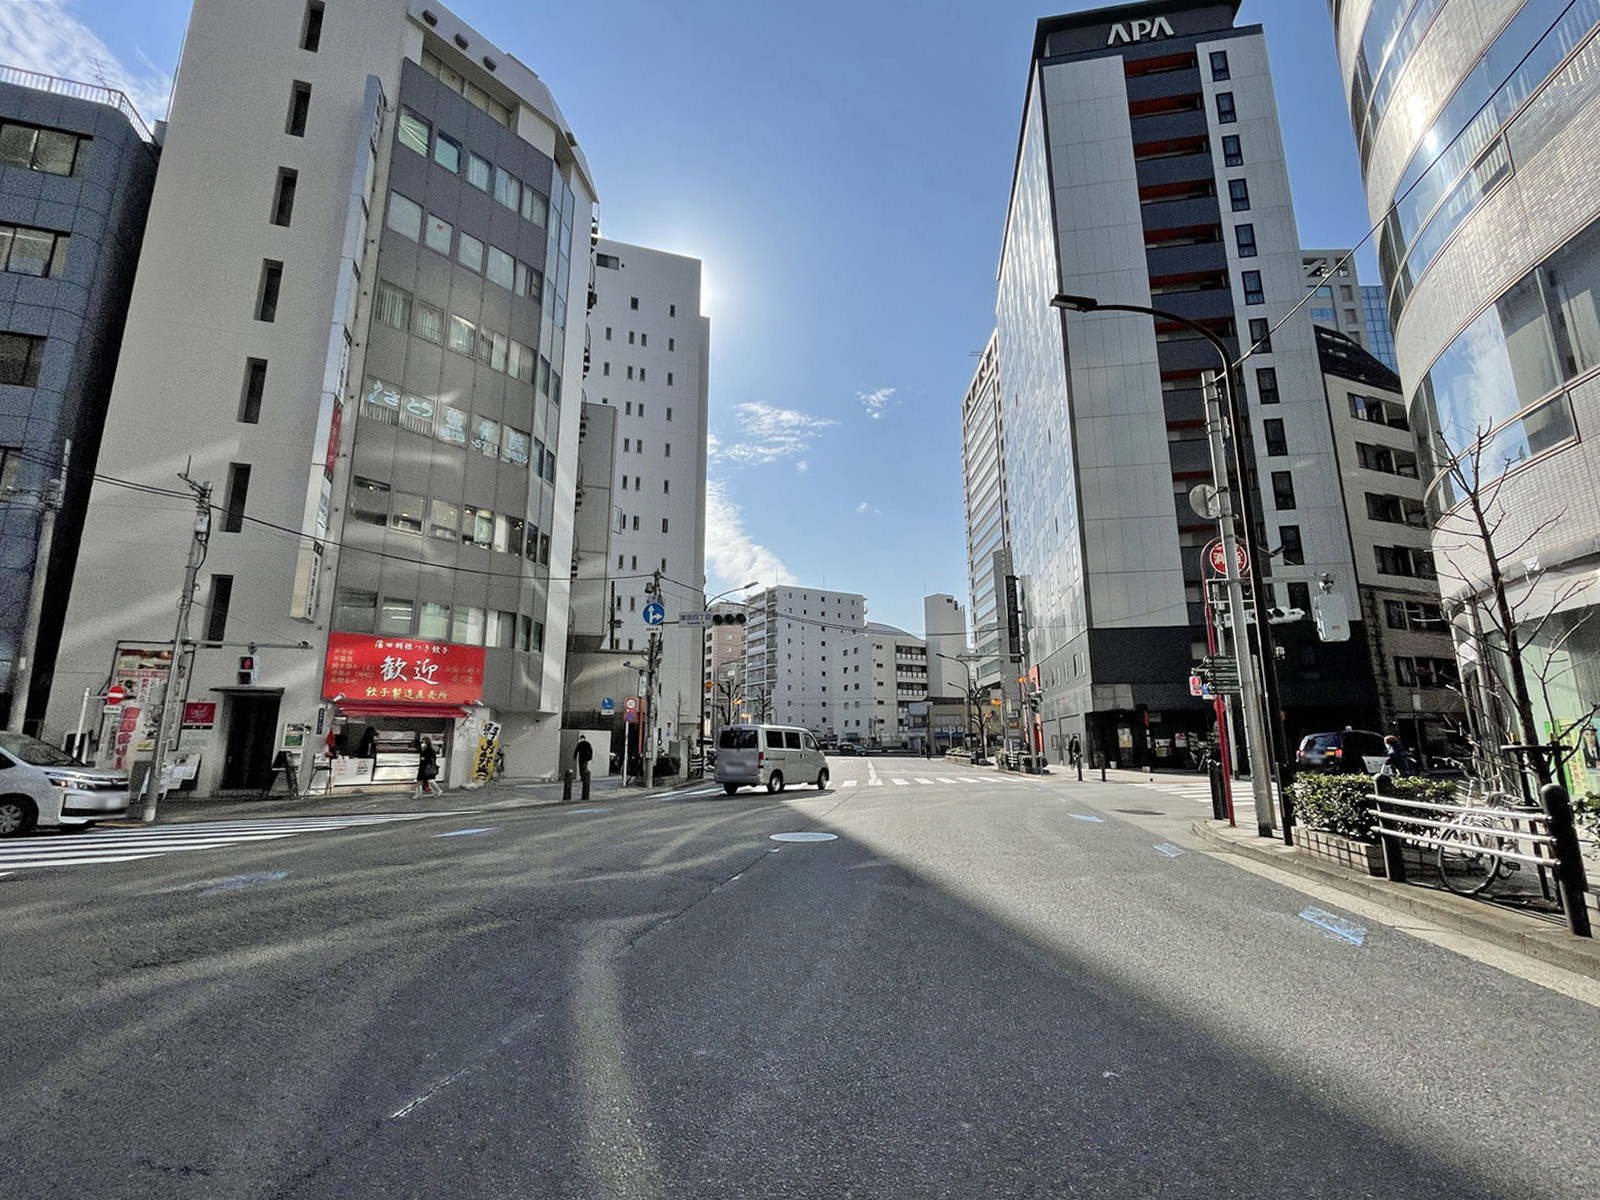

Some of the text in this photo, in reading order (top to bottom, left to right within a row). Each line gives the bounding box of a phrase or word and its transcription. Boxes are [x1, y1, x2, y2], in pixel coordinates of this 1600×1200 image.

[1107, 16, 1175, 46] APA
[380, 655, 439, 685] 歓迎
[366, 686, 449, 700] 餃子製造直売所
[475, 740, 496, 781] お弁当
